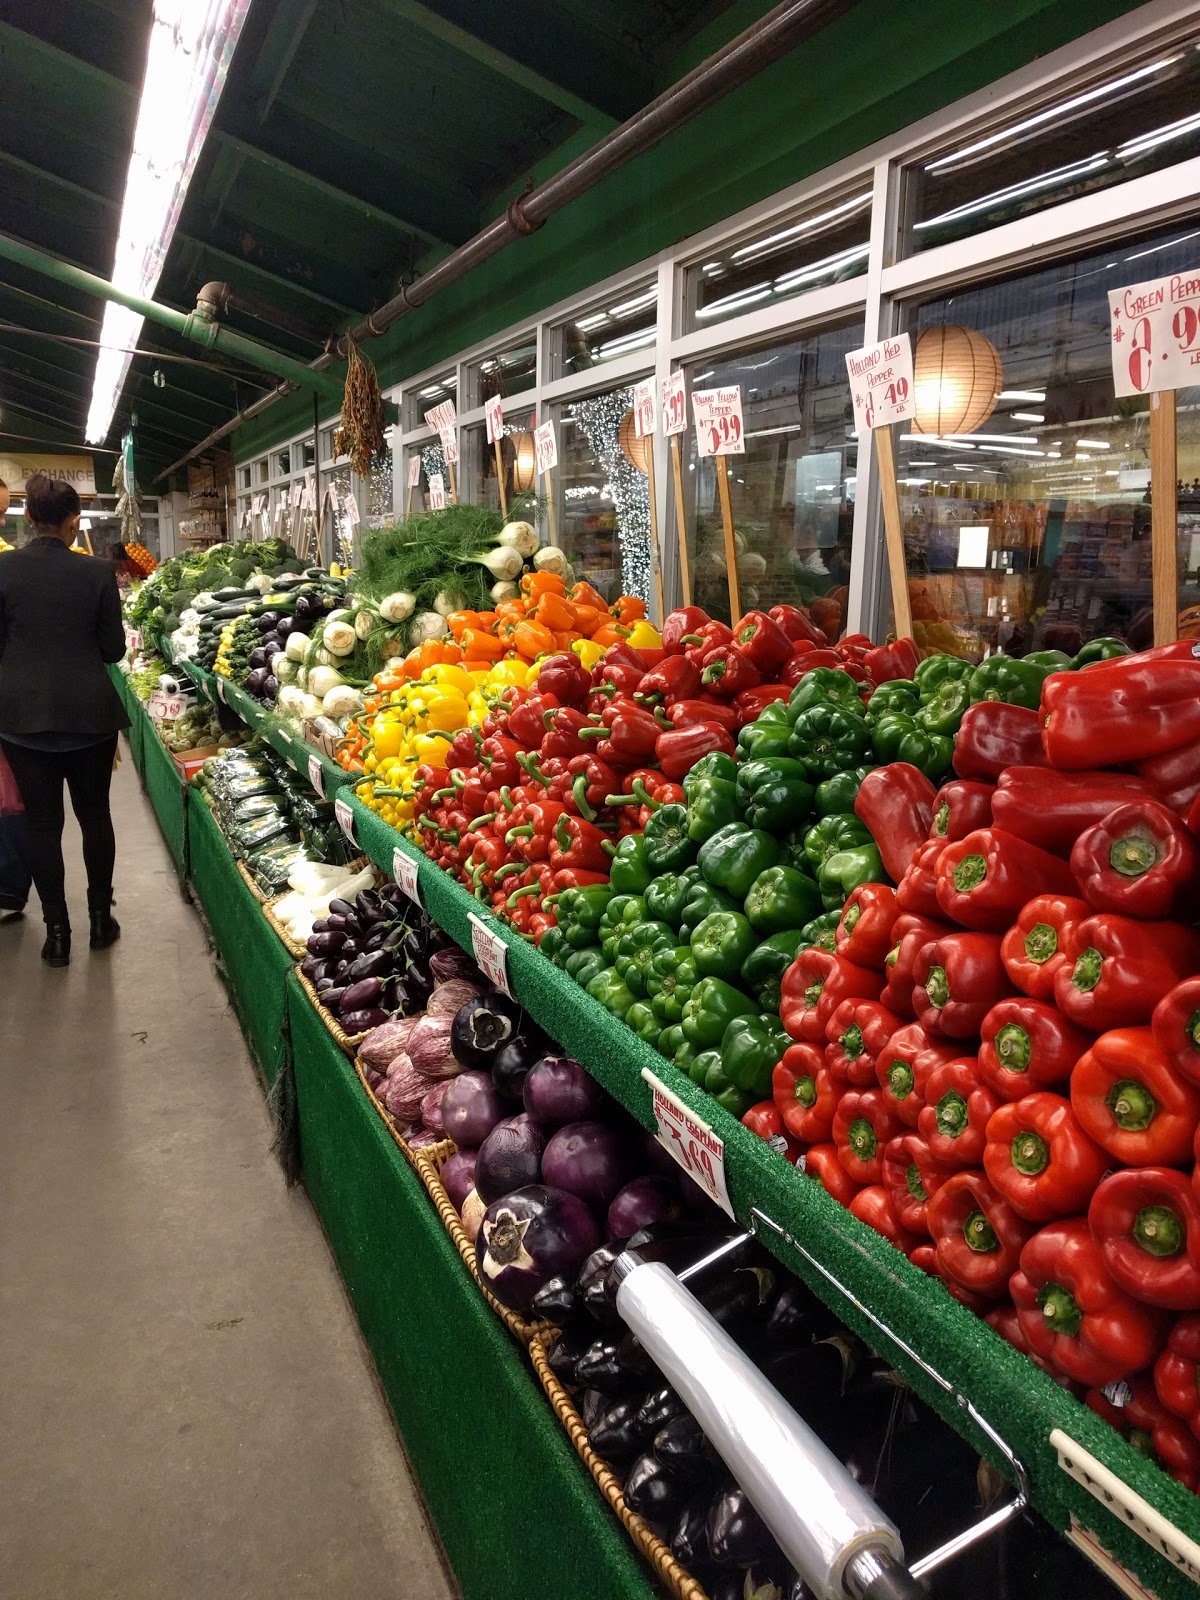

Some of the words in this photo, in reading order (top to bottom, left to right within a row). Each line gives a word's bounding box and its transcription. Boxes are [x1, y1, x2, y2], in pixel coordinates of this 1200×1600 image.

[1124, 288, 1164, 319] GREEN
[849, 350, 881, 377] HOLLAND
[883, 341, 901, 360] RED
[867, 368, 894, 389] PEPPER
[709, 403, 732, 415] PEPPERS
